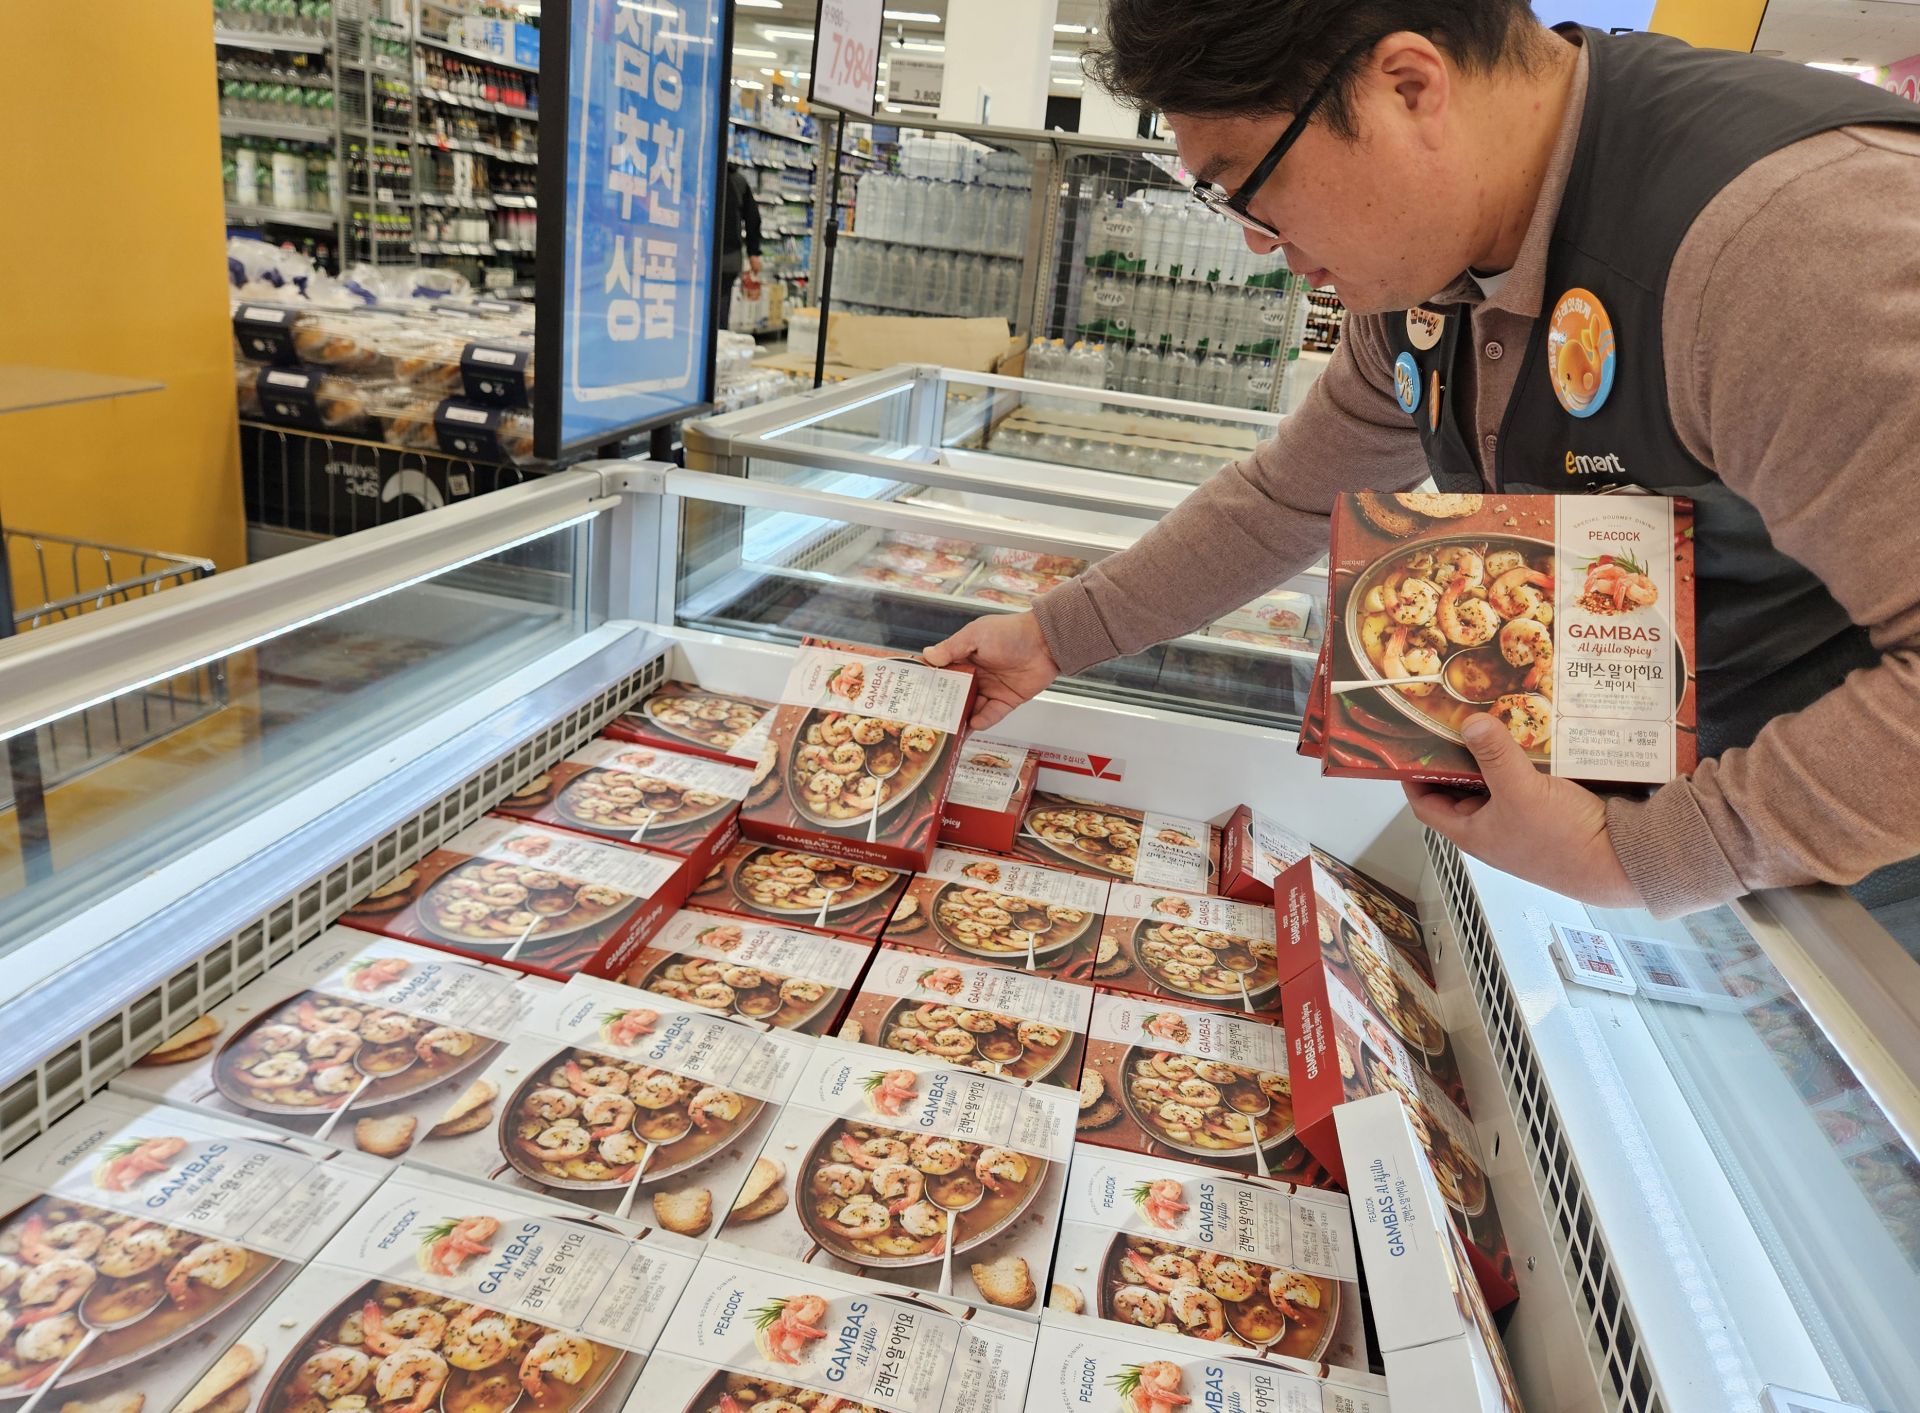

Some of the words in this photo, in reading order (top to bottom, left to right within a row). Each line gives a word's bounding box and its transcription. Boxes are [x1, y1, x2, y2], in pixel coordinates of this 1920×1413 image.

[614, 0, 688, 112] 점장
[830, 31, 874, 91] 7,984
[608, 107, 684, 228] 추천
[604, 235, 678, 341] 상품
[1565, 450, 1626, 474] emart
[1588, 531, 1640, 541] PEACOCK
[1568, 624, 1661, 642] GAMBAS
[1577, 642, 1589, 652] Al
[1592, 642, 1622, 657] Ajillo
[1623, 645, 1652, 659] Spicy
[864, 665, 887, 710] GAMBAS
[1567, 662, 1605, 678] 감바스
[1608, 664, 1622, 680] 알
[1625, 664, 1664, 681] 아히요
[1594, 680, 1636, 693] 스파이시
[776, 833, 830, 849] GAMBAS
[1148, 841, 1201, 858] GAMBAS
[740, 929, 771, 962] GAMBAS
[1290, 915, 1301, 945] GAMBAS
[388, 963, 444, 1006] GAMBAS
[968, 971, 988, 1004] GAMBAS
[567, 1000, 596, 1028] PEACOCK
[649, 1014, 691, 1061] GAMBAS
[1199, 1017, 1211, 1054] GAMBAS
[684, 1048, 707, 1072] 감바스
[1304, 1039, 1319, 1080] GAMBAS
[831, 1065, 853, 1097] PEACOCK
[919, 1074, 950, 1127] GAMBAS
[956, 1111, 977, 1135] 감바스
[969, 1081, 986, 1103] 아히요
[146, 1142, 229, 1210] GAMBAS
[1103, 1175, 1117, 1209] PEACOCK
[187, 1192, 223, 1221] 감바스
[1199, 1183, 1215, 1244] GAMBAS
[1238, 1190, 1253, 1213] 아히요
[1366, 1196, 1377, 1223] PEACOCK
[377, 1208, 421, 1250] PEACOCK
[1238, 1212, 1255, 1226] 알
[1378, 1195, 1406, 1257] GAMBAS
[555, 1233, 586, 1263] 아히요
[1239, 1226, 1255, 1253] 감바스
[478, 1222, 542, 1295] GAMBAS
[546, 1260, 566, 1276] 알
[521, 1275, 557, 1310] 감바스
[713, 1289, 745, 1337] PEACOCK
[891, 1312, 915, 1346] 아히요
[826, 1301, 869, 1383] GAMBAS
[886, 1344, 906, 1360] 알
[873, 1356, 899, 1399] 감바스
[1079, 1357, 1097, 1404] PEACOCK
[1205, 1366, 1224, 1413] MBAS
[1255, 1375, 1275, 1408] 아히요
